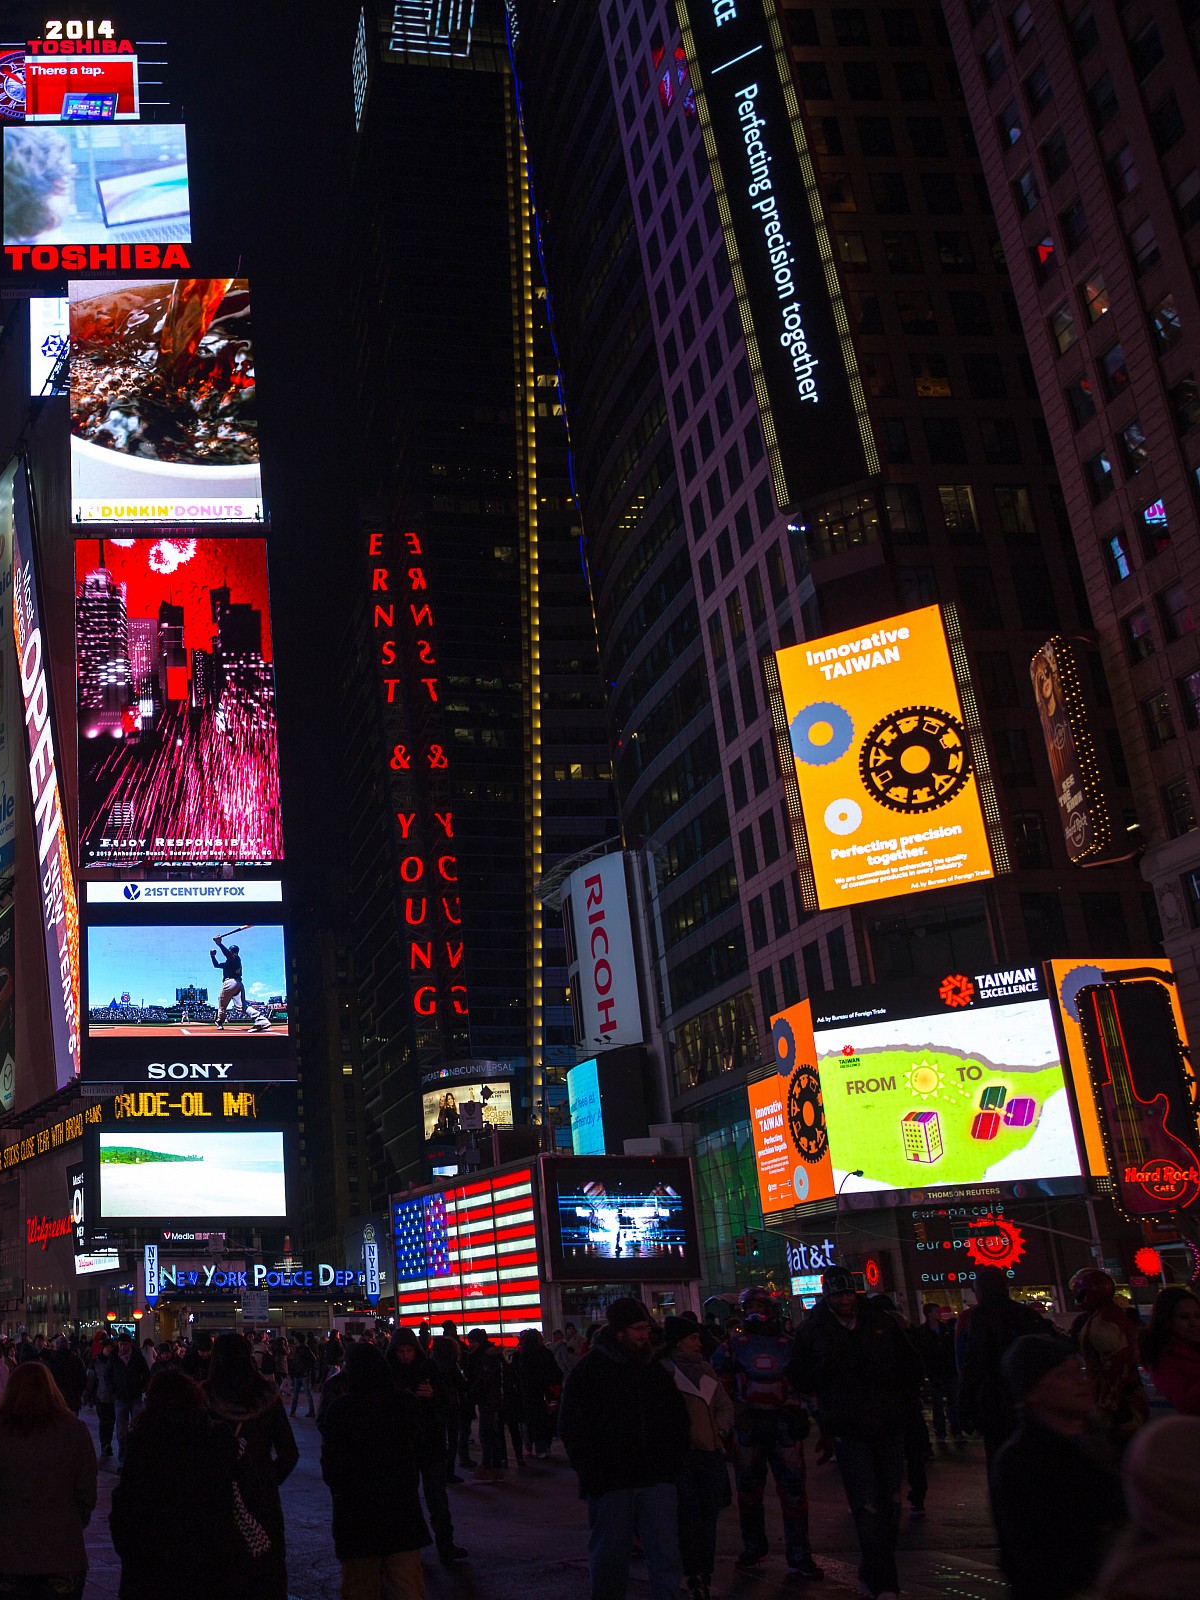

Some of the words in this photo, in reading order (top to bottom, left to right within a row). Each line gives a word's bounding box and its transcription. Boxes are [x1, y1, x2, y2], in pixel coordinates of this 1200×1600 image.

[45, 20, 115, 40] 2014
[27, 40, 134, 54] TOSHIBA
[29, 66, 68, 75] There
[81, 66, 104, 77] tap.
[734, 82, 772, 197] Perfecting
[5, 244, 191, 270] TOSHIBA
[751, 197, 795, 299] precision
[780, 302, 819, 403] together
[102, 505, 174, 517] DUNKIN'
[175, 505, 243, 517] DONUTS
[369, 533, 400, 702] ERNST
[806, 626, 910, 667] Innovative
[820, 646, 901, 681] TAIWAN
[21, 627, 63, 867] OPEN
[389, 744, 411, 769] &
[99, 838, 146, 848] ENJOY
[830, 838, 898, 861] Perfecting
[900, 824, 963, 848] precision
[867, 846, 928, 866] together.
[856, 869, 891, 881] committed
[880, 872, 909, 884] products
[916, 867, 935, 876] every
[927, 878, 947, 886] Bureau
[954, 872, 975, 881] Foreign
[145, 887, 169, 896] 21ST
[172, 887, 221, 896] CENTURY
[223, 887, 245, 896] FOX
[397, 813, 437, 1015] YOUNG
[584, 873, 617, 1033] RICOH
[975, 967, 1036, 989] TAIWAN
[979, 983, 1039, 999] EXCELLENCE
[854, 1010, 872, 1019] Foreign
[148, 1063, 233, 1079] SONY
[449, 1063, 514, 1076] NBCUNIVERSAL
[846, 1076, 897, 1095] FROM
[956, 1065, 982, 1082] TO
[115, 1092, 212, 1119] CRUDE-OIL
[759, 1114, 784, 1132] TAIWAN
[20, 1135, 36, 1161] CLOSE
[36, 1129, 50, 1155] YEAR
[763, 1134, 783, 1146] Perfecting
[1124, 1167, 1160, 1183] Hard
[1162, 1166, 1200, 1184] Rock
[927, 1190, 965, 1199] THOMSON
[966, 1187, 1000, 1196] REUTERS
[171, 1232, 195, 1240] Media
[917, 1239, 971, 1250] europa
[792, 1239, 837, 1271] at&t
[148, 1246, 156, 1294] NYPD
[160, 1264, 199, 1287] NEW
[202, 1264, 248, 1287] YORK
[253, 1264, 313, 1287] POLICE
[368, 1246, 377, 1293] NYPD
[921, 1271, 977, 1283] europa
